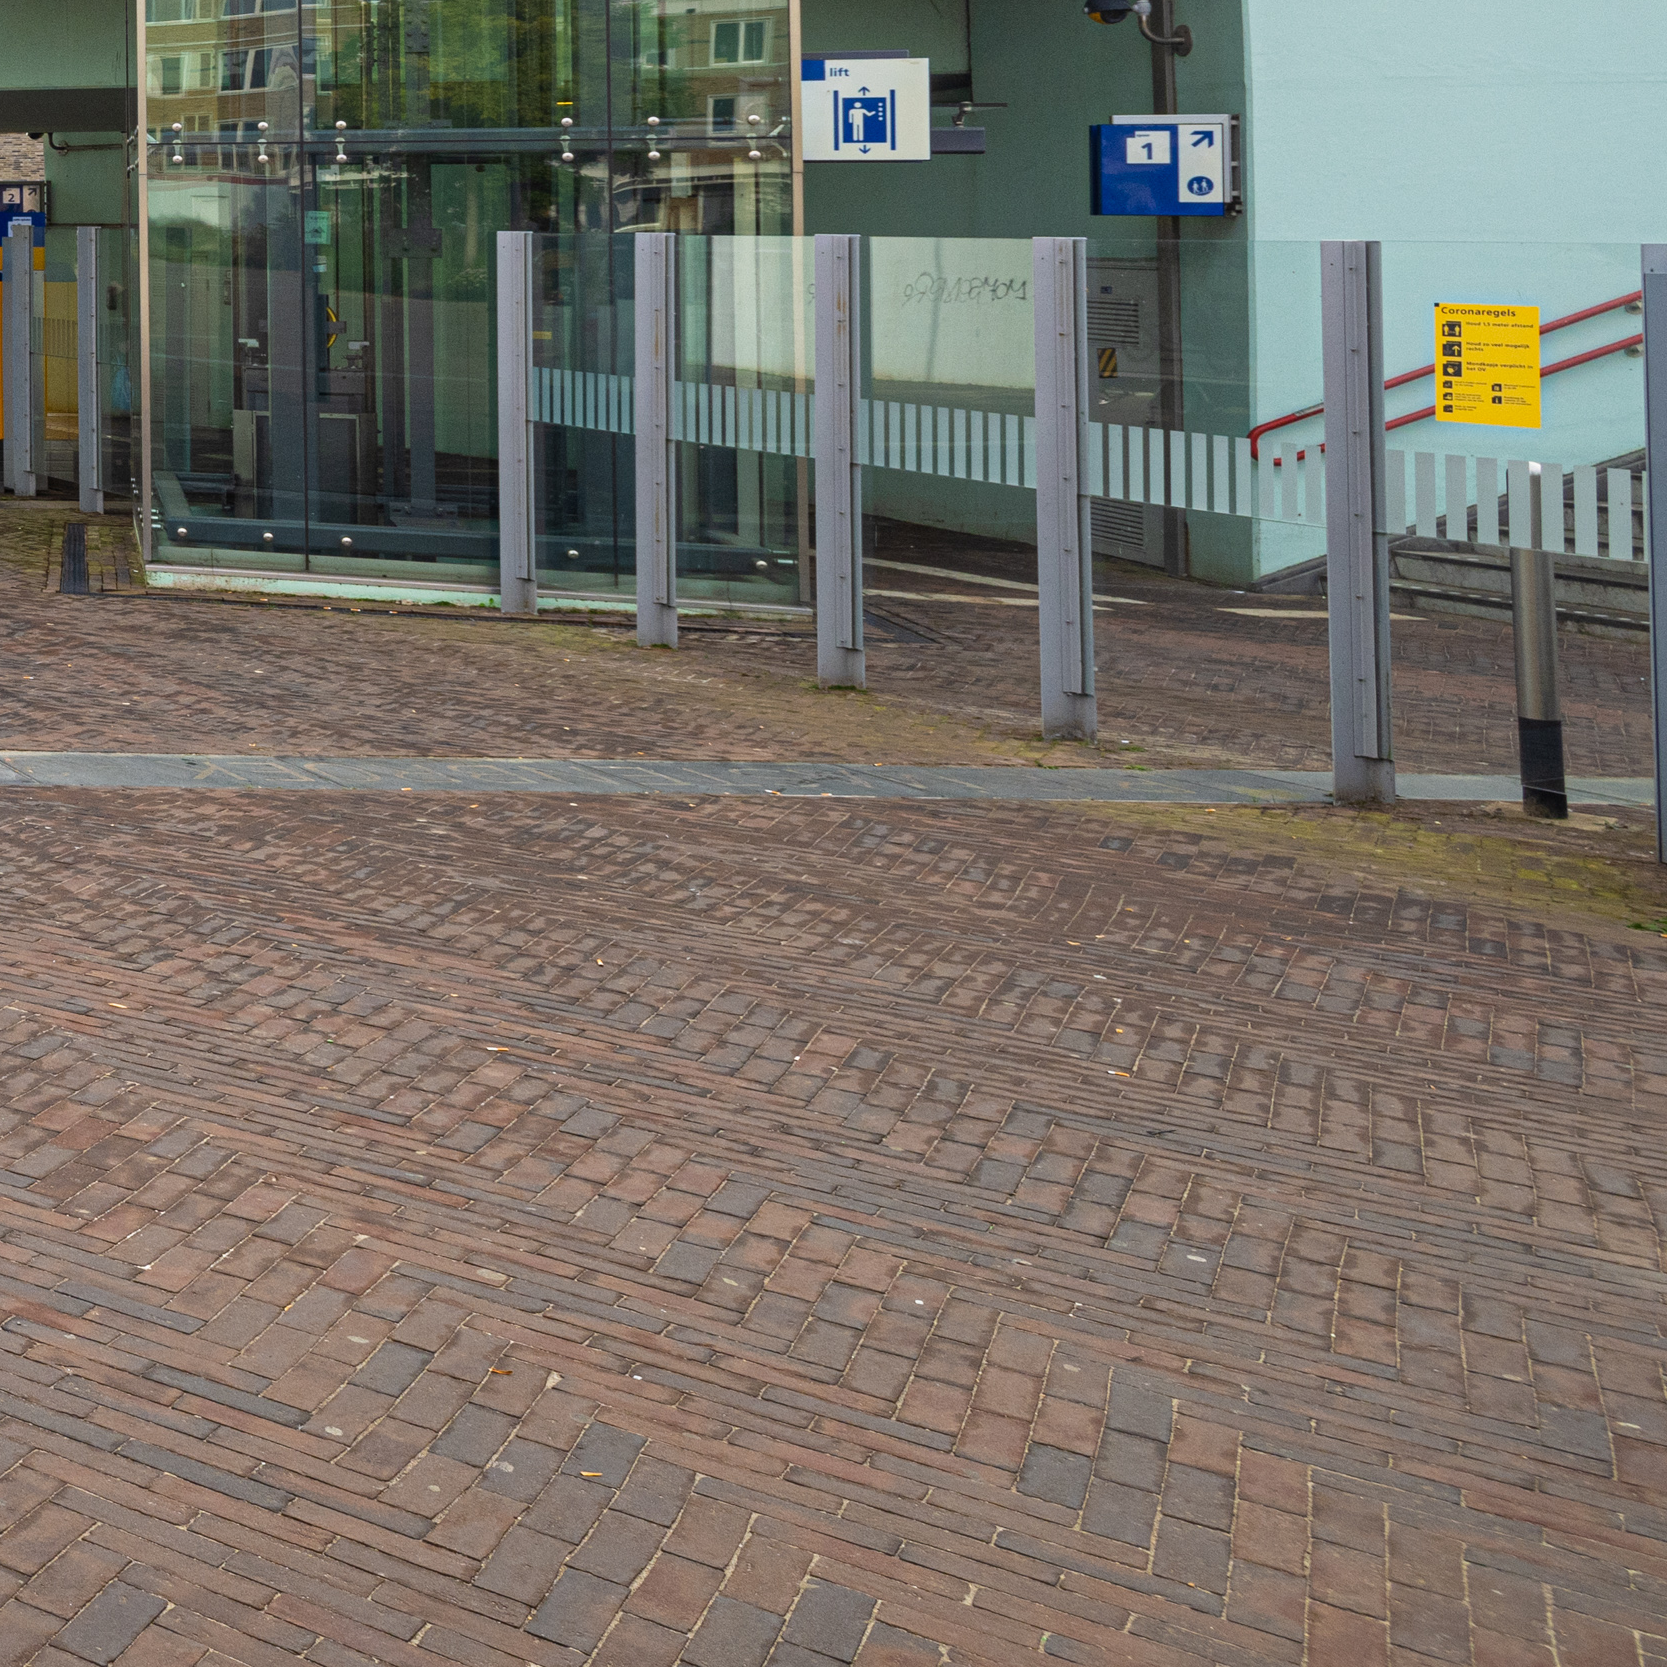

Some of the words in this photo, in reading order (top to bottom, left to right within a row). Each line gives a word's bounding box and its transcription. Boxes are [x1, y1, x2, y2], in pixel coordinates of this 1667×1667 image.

[829, 67, 850, 77] lift
[1140, 142, 1153, 160] 1
[8, 193, 15, 202] 2
[1441, 306, 1516, 318] Coronaregels
